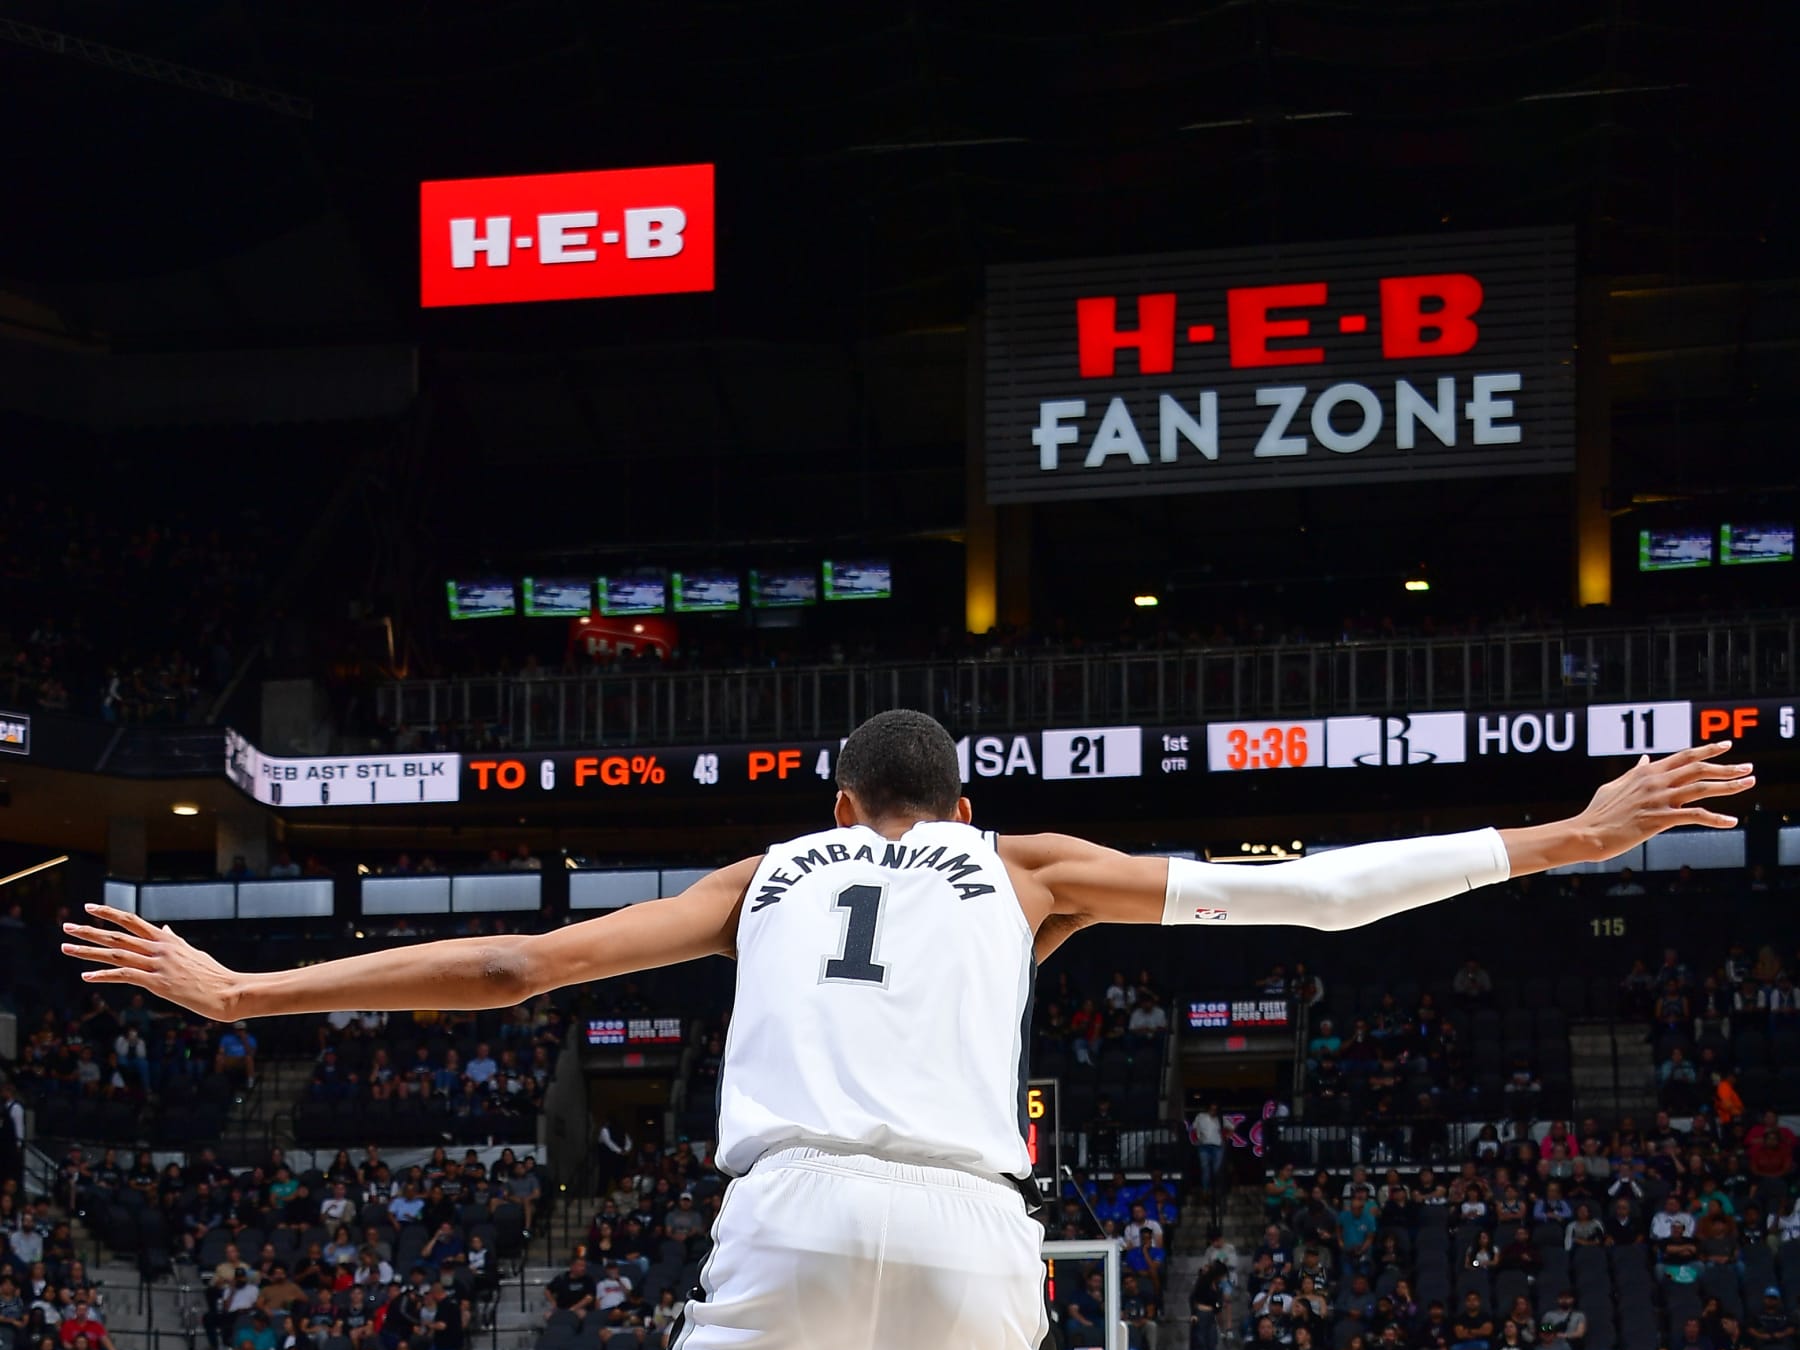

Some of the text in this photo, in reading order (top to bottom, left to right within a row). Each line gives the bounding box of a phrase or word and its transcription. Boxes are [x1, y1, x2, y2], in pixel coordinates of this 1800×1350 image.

[450, 205, 686, 268] H-E-B
[1077, 273, 1483, 378] H-E-B
[1032, 373, 1522, 470] FAN ZONE
[1162, 735, 1189, 751] 1st
[1227, 726, 1308, 770] 3:36
[1478, 707, 1794, 755] HOU 11 PF 5
[263, 762, 444, 780] REB AST STL BLK
[470, 754, 719, 790] TO 6 FG% 43
[748, 750, 829, 780] PF 4
[1070, 735, 1107, 774] 21
[1161, 759, 1187, 772] QTR
[320, 782, 330, 804] 6
[370, 781, 377, 803] 1
[418, 779, 425, 801] 1
[750, 843, 996, 913] WEMBANYAMA
[818, 881, 892, 991] 1
[1590, 918, 1625, 937] 115
